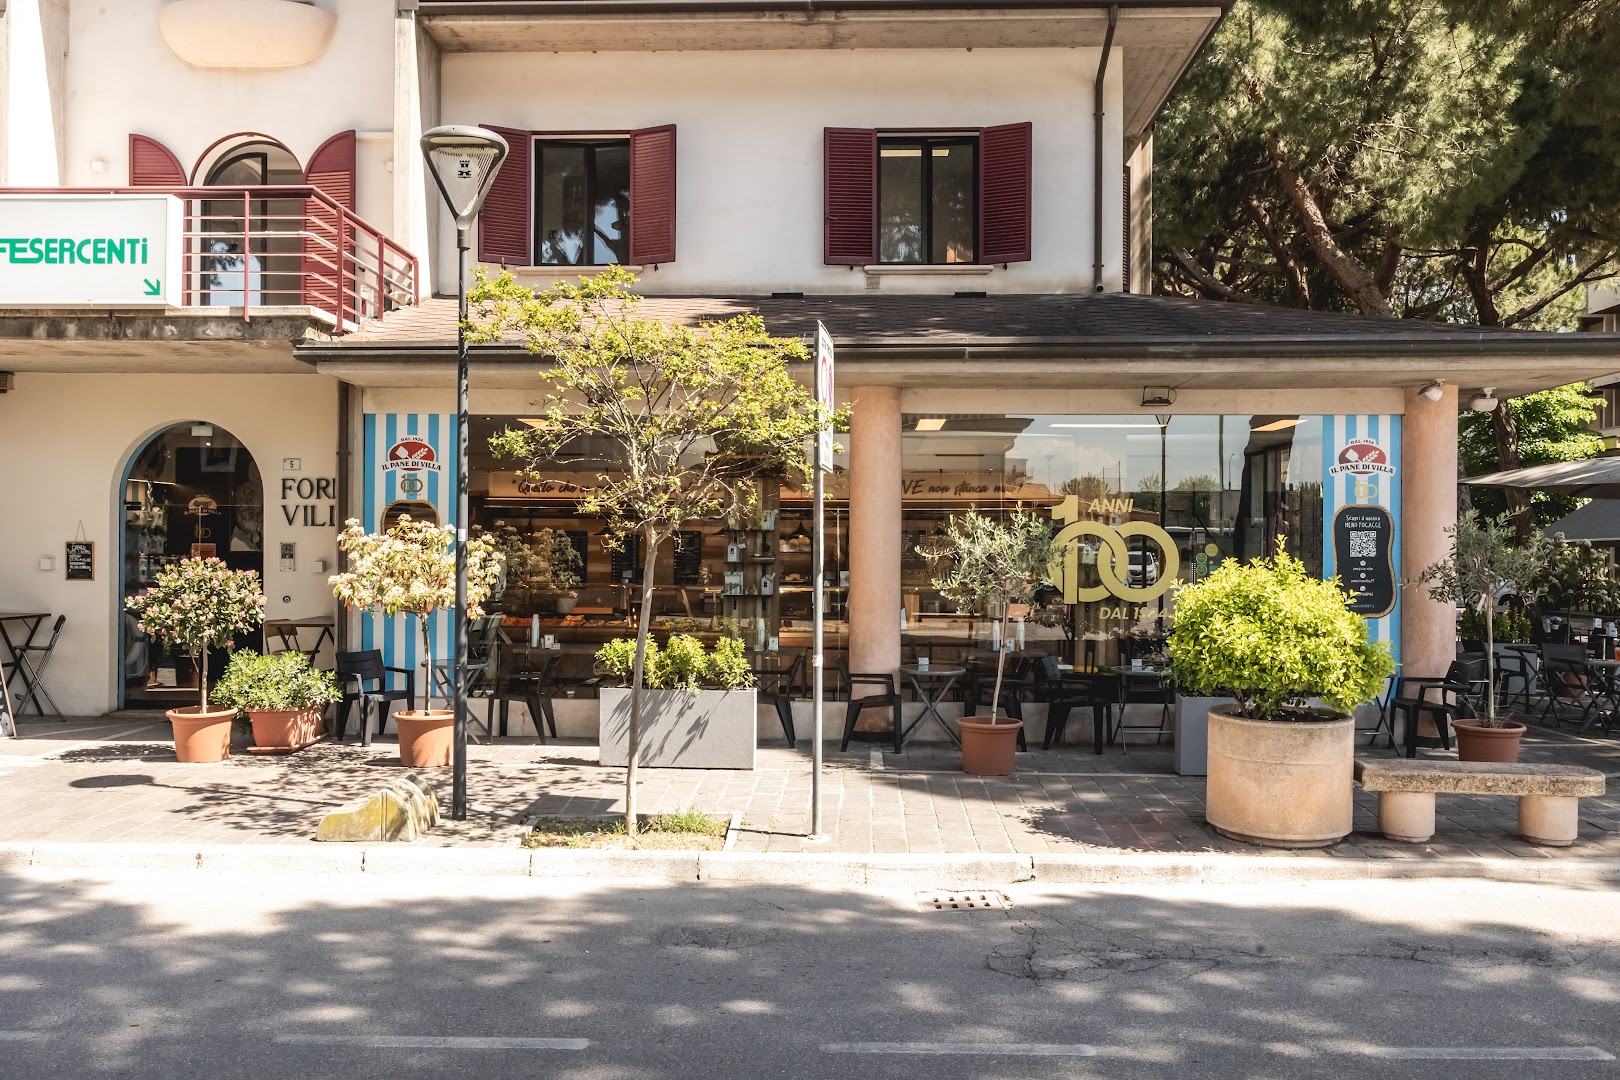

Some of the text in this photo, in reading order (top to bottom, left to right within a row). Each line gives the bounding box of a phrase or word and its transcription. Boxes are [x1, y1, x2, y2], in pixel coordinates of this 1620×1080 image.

[289, 460, 294, 469] 5
[421, 461, 442, 471] VILLA
[1340, 464, 1360, 472] PANE
[1371, 464, 1394, 474] VILLA
[928, 485, 951, 493] non
[953, 481, 989, 496] stanca
[1087, 498, 1134, 513] ANNI
[1099, 606, 1129, 620] DAL
